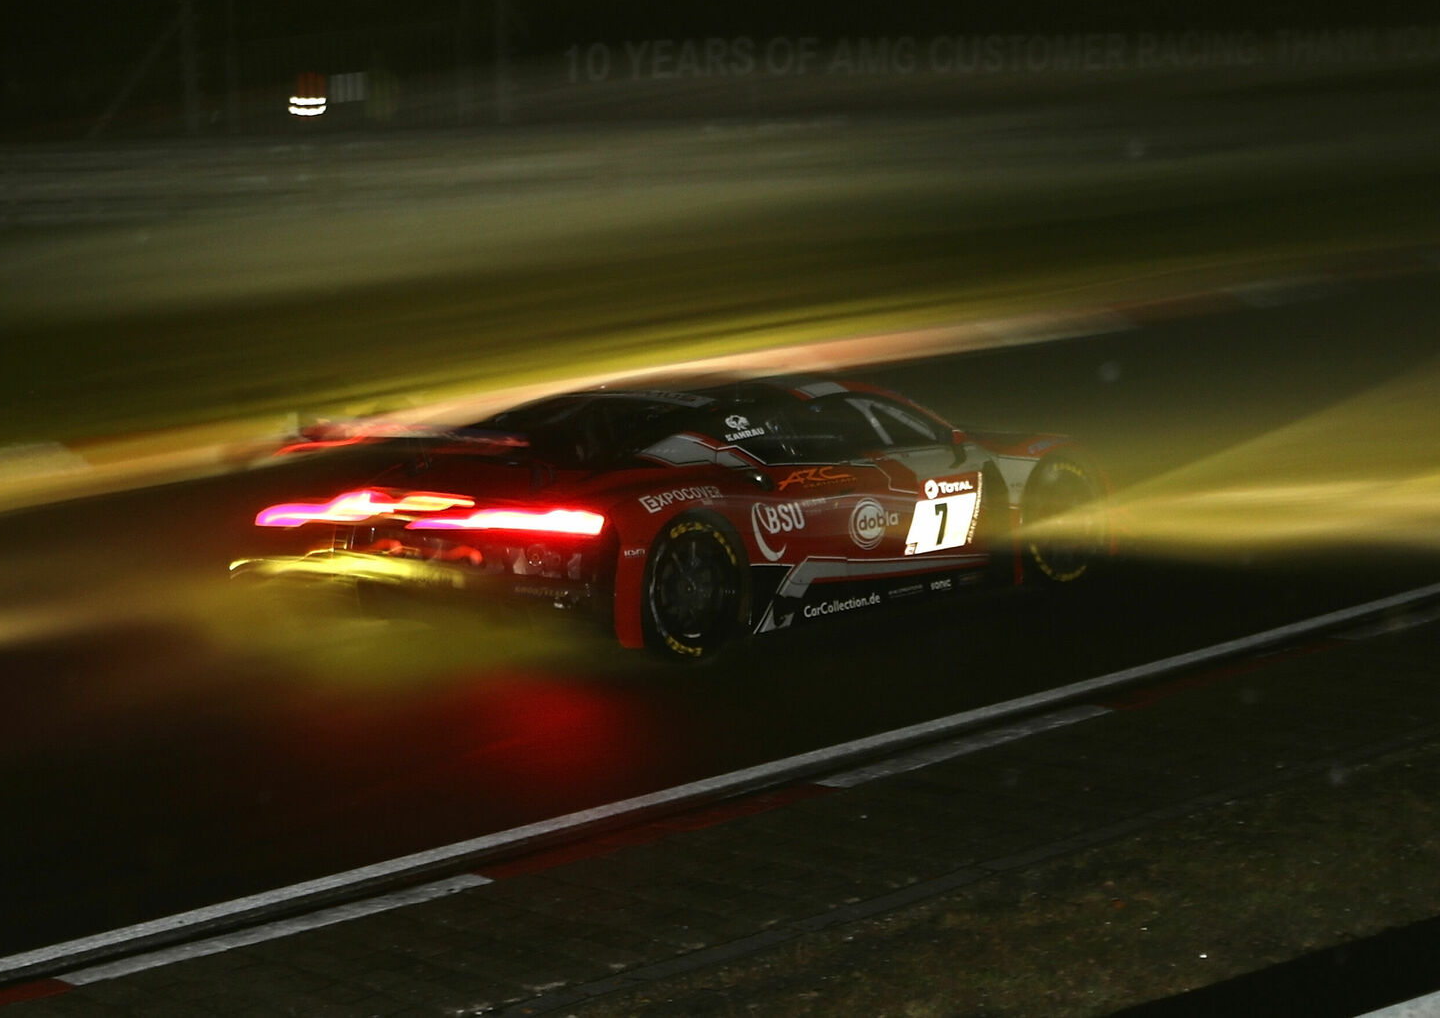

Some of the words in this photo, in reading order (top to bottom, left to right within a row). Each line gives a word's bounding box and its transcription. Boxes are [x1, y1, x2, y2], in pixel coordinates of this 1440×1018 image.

[564, 42, 611, 83] 10
[623, 37, 756, 80] YEARS
[764, 36, 820, 76] OF
[827, 36, 918, 76] AMG
[929, 33, 1128, 74] CUSTOMER
[638, 485, 724, 514] EXPOCOVER
[938, 480, 973, 494] TOTAL
[765, 501, 806, 535] BSU
[858, 511, 899, 532] dobla
[934, 502, 948, 546] 7
[803, 592, 881, 618] CarCollection.de
